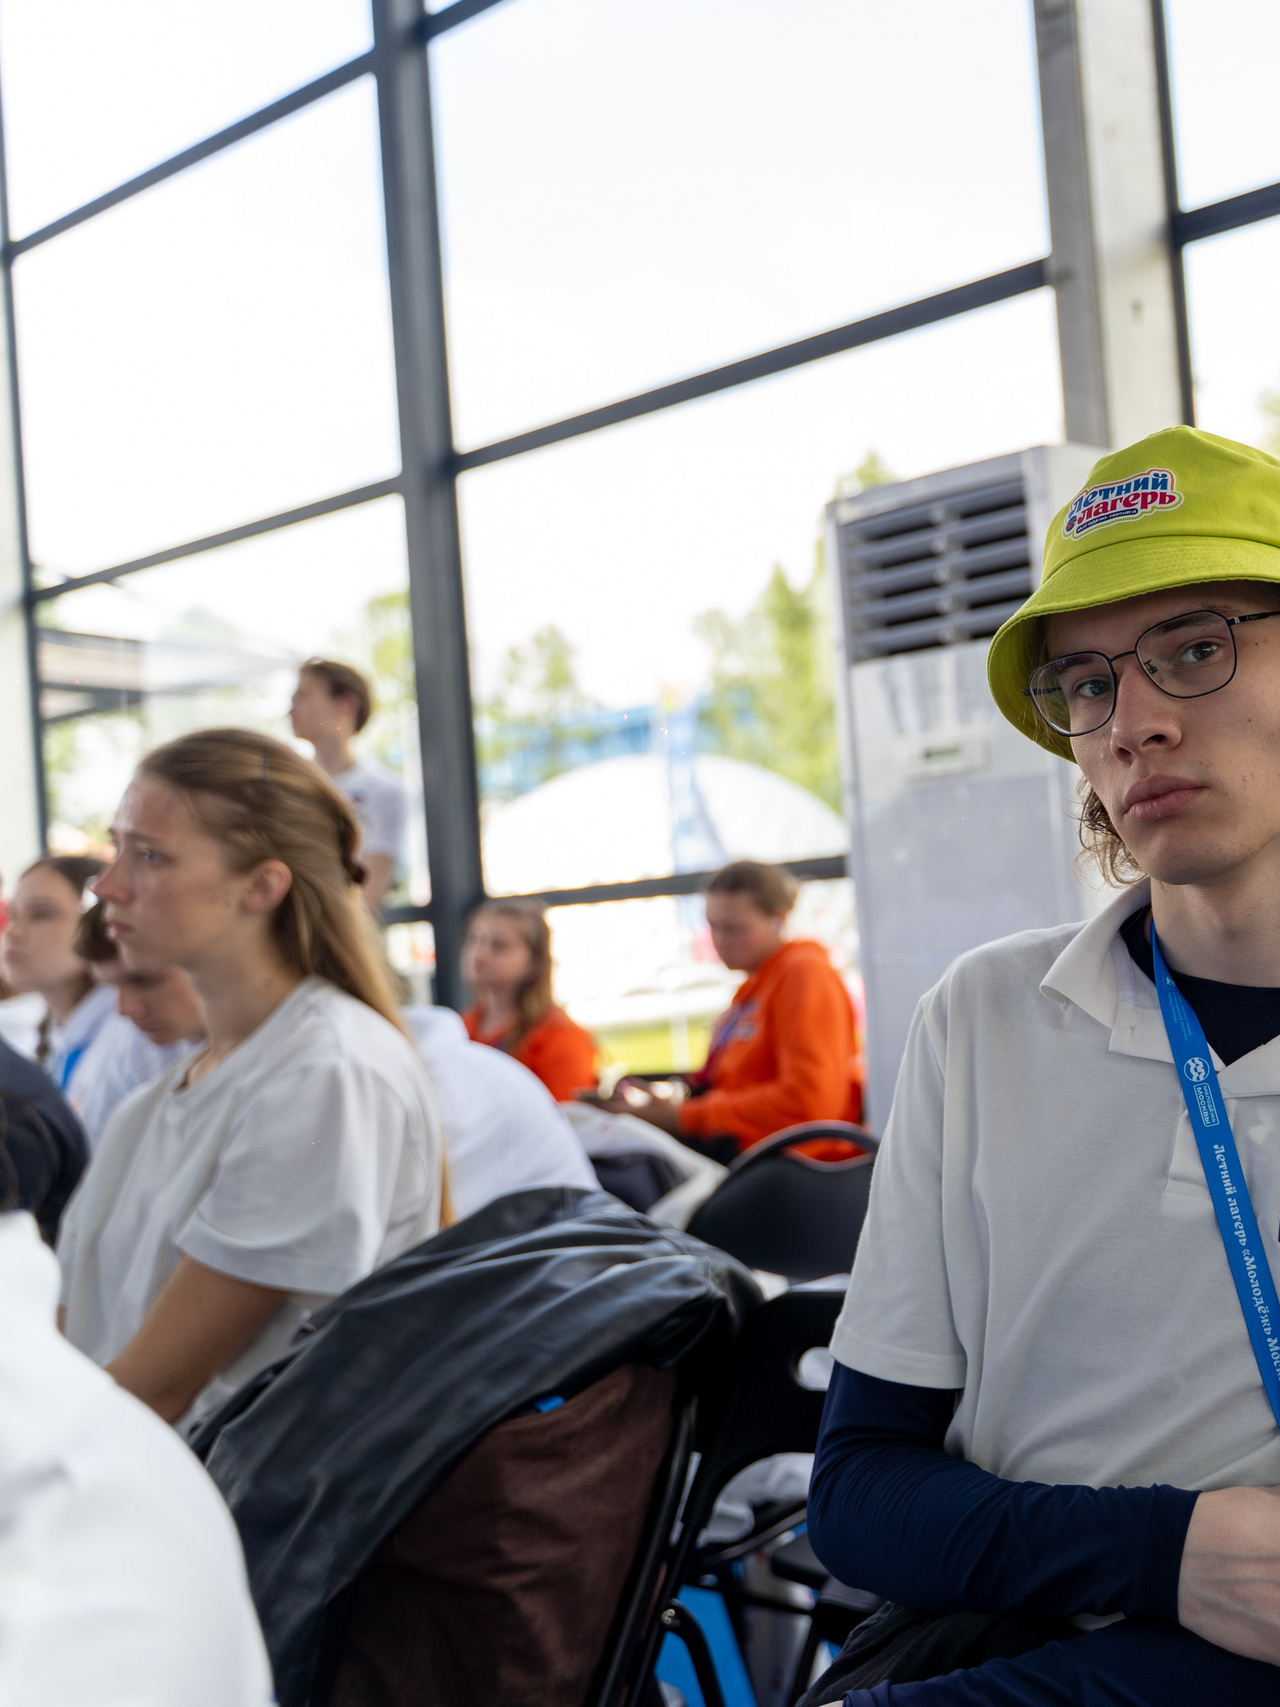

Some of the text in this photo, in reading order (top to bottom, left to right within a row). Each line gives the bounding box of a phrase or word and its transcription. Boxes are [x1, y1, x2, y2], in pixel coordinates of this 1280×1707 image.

[1196, 1086, 1211, 1125] МОСКВЫ
[1213, 1144, 1237, 1195] Летний
[1227, 1197, 1247, 1246] лагерь
